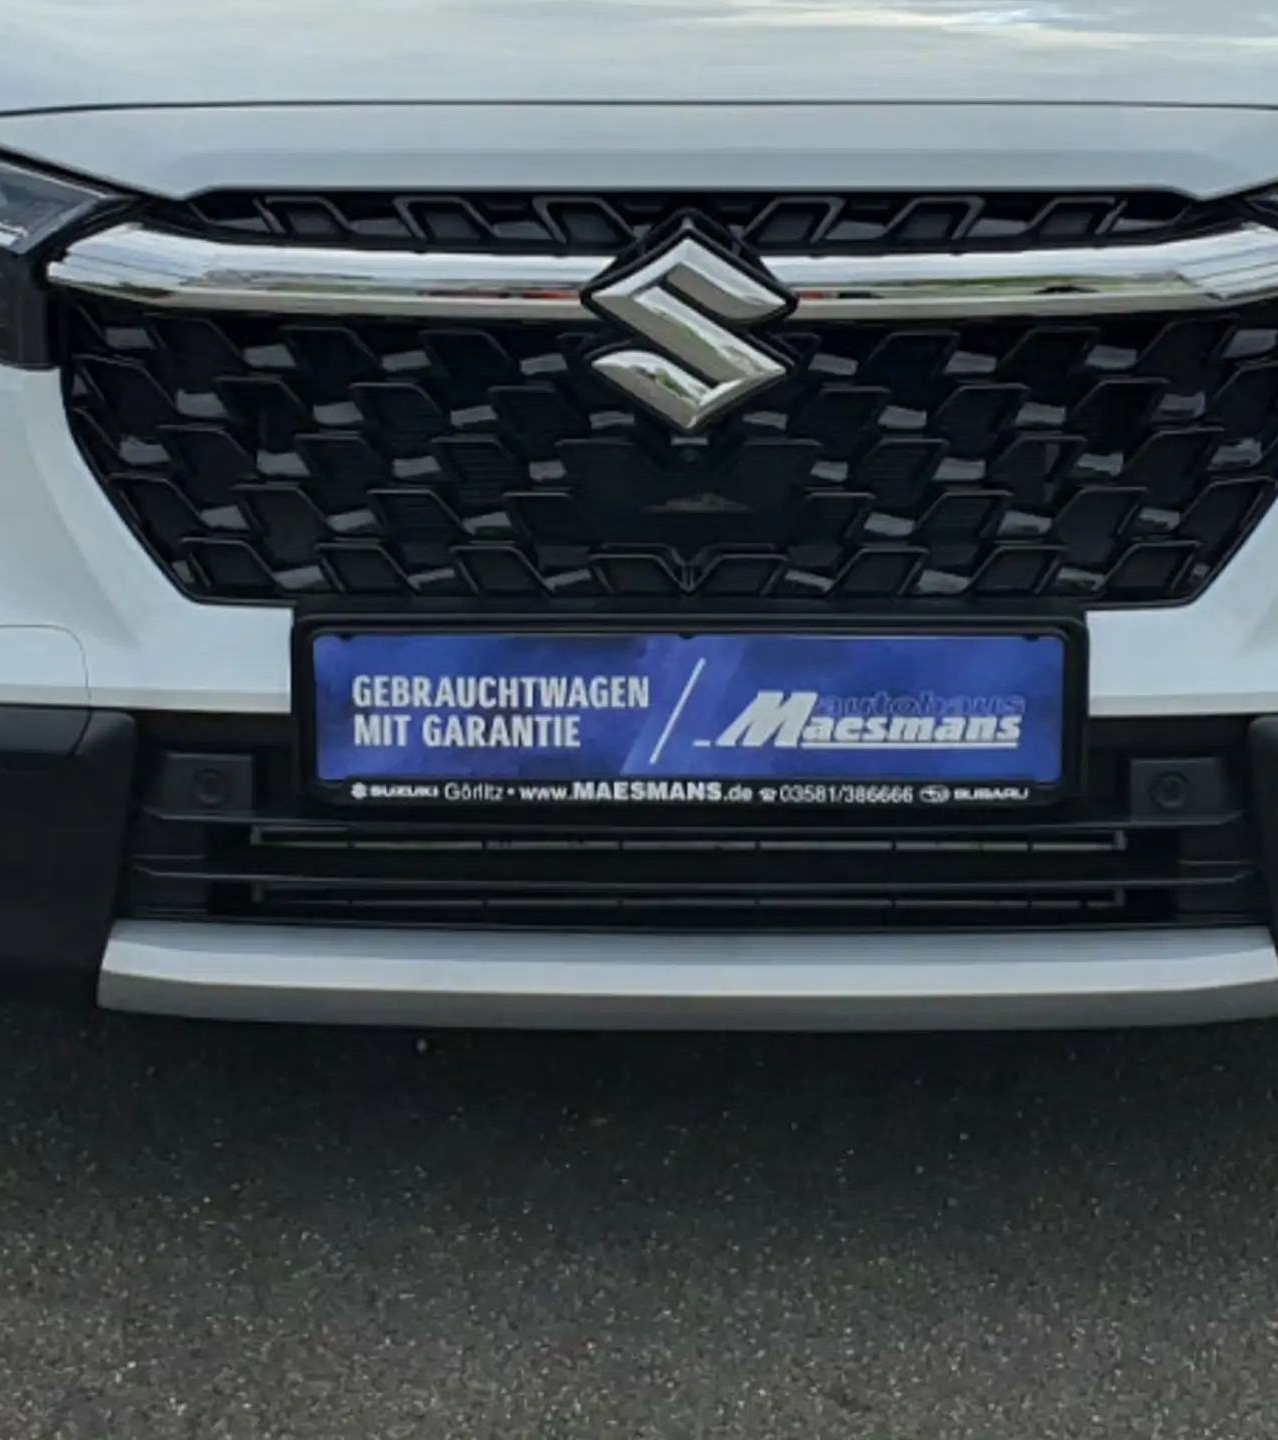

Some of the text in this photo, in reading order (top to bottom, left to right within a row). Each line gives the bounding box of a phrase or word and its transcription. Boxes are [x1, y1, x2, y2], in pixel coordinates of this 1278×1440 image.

[352, 675, 649, 708] GEBRAUCHTWAGEN
[354, 714, 580, 747] MIT GARANTIE
[716, 691, 1021, 748] Maesmans
[369, 780, 1029, 803] SUZUKI Görlitz www.MAESMANS.de 03581/386666 SUBARU
